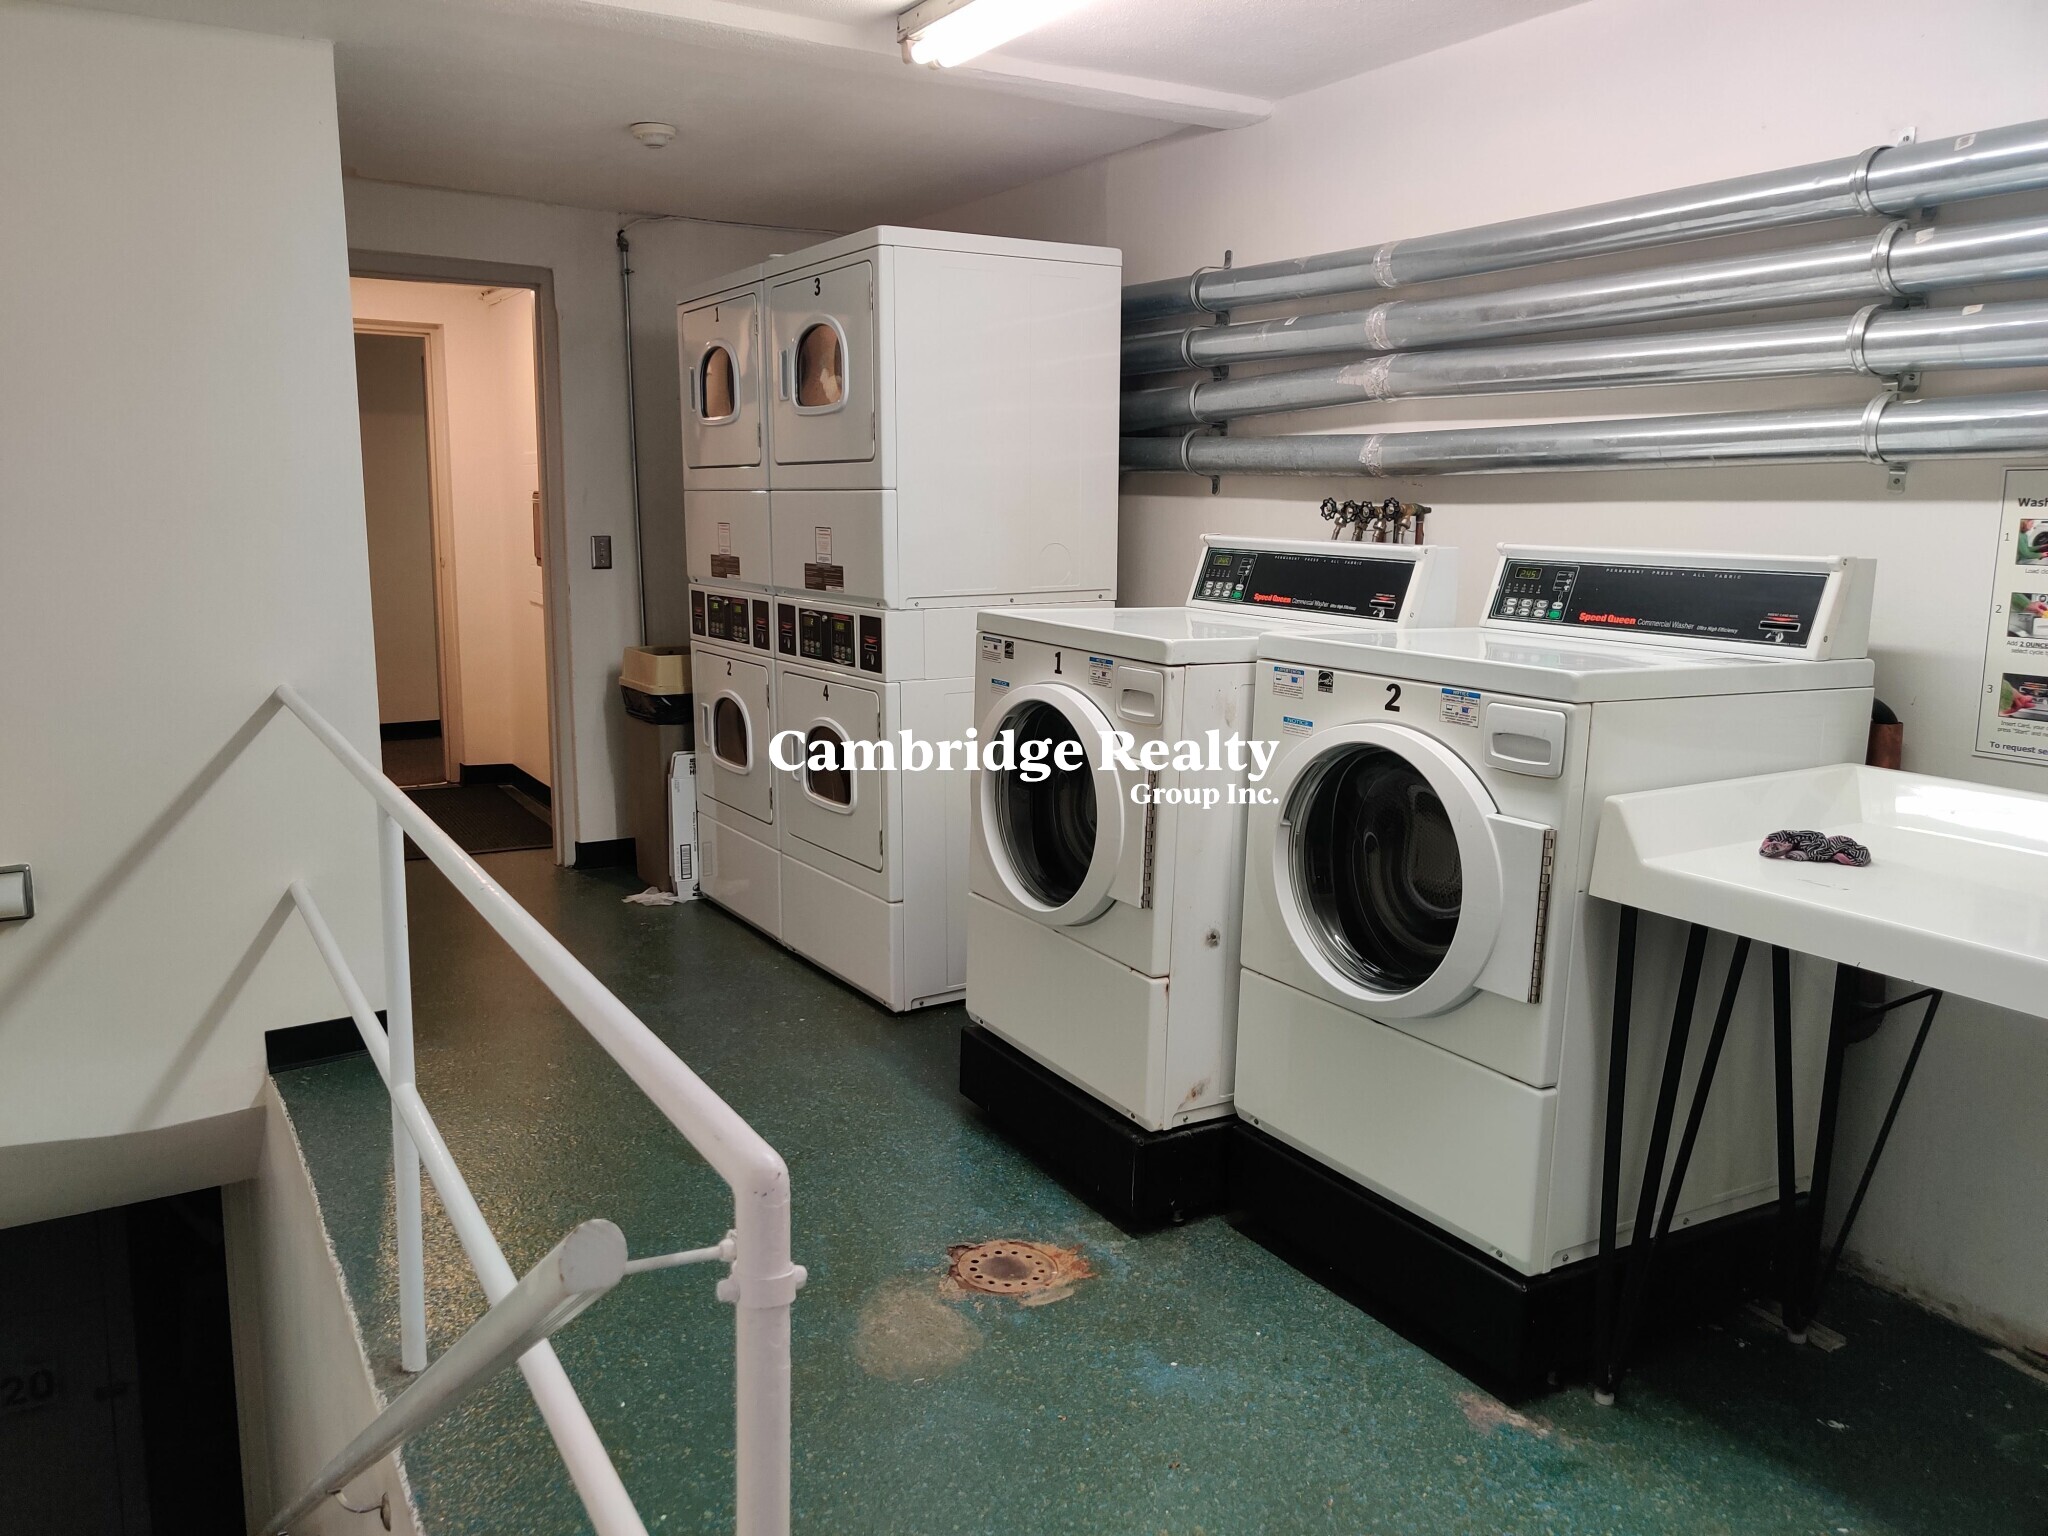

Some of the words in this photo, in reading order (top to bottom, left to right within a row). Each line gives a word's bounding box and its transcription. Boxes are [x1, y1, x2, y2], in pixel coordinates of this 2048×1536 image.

[814, 277, 821, 296] 3
[715, 306, 719, 322] 1
[2004, 532, 2010, 541] 1
[1254, 593, 1273, 602] Speed
[1273, 594, 1291, 603] Queen
[1995, 605, 2002, 613] 2
[1579, 612, 1608, 623] Speed
[1607, 614, 1637, 625] Queen
[1637, 618, 1672, 628] Commercial
[1671, 621, 1695, 630] Washer
[726, 661, 732, 676] 2
[1053, 651, 1062, 674] 1
[822, 684, 829, 701] 4
[1986, 684, 1994, 693] 3
[1384, 683, 1402, 712] 2
[1990, 741, 2000, 749] To
[2003, 744, 2036, 753] request
